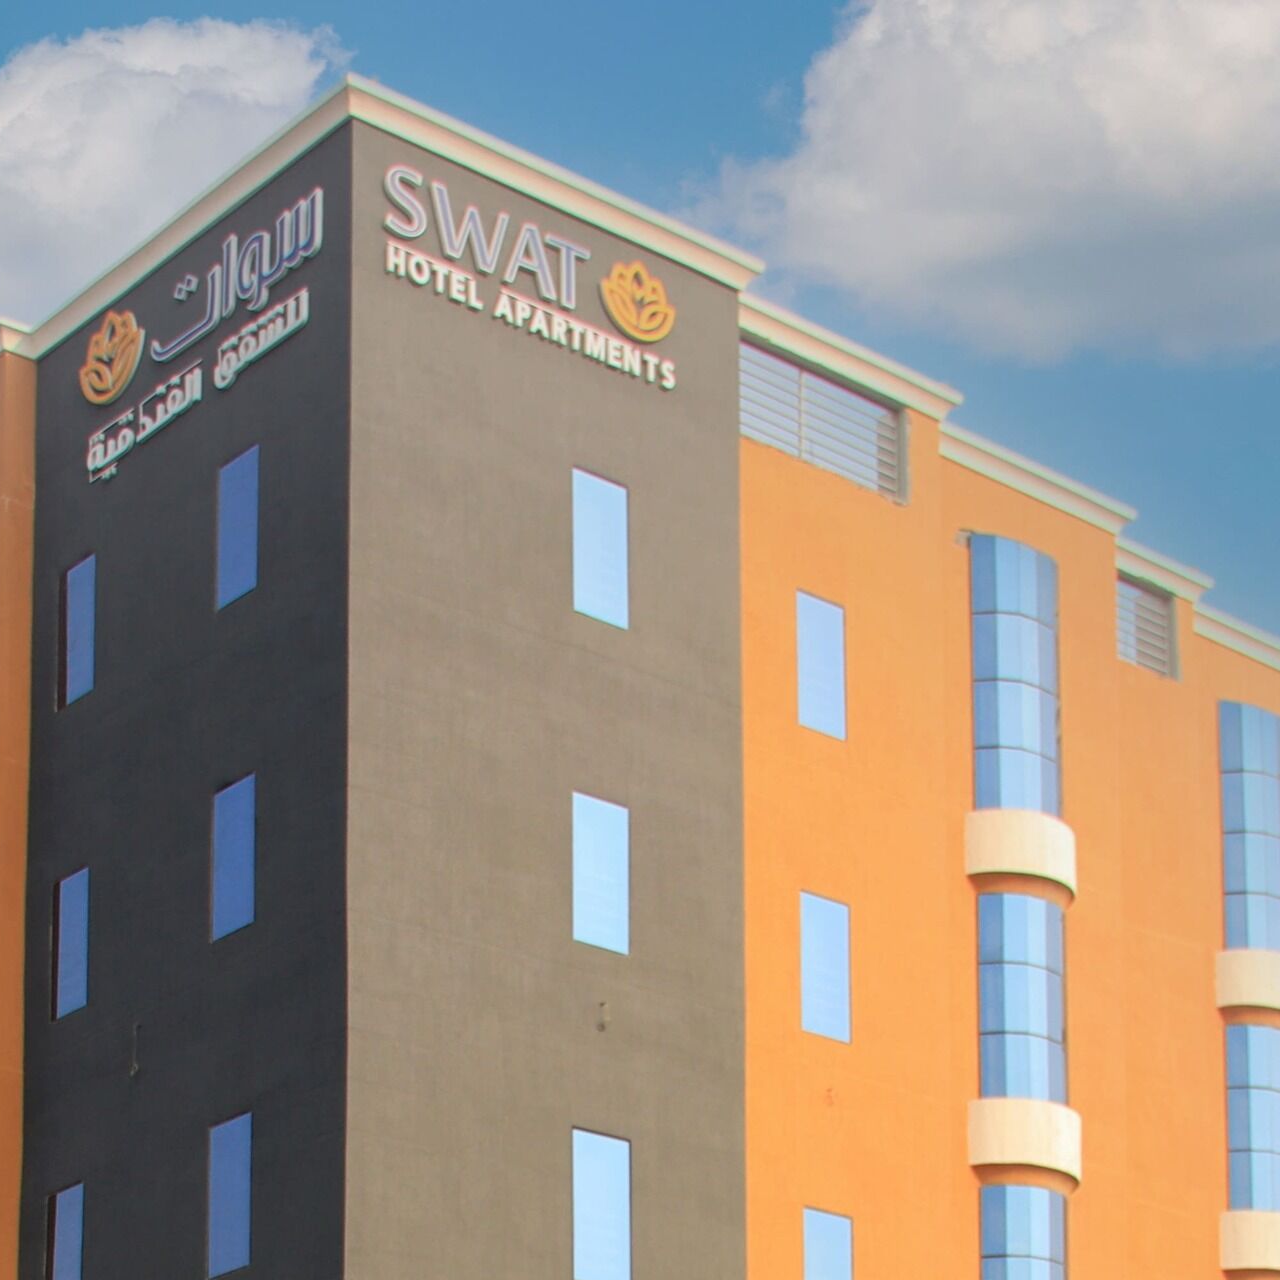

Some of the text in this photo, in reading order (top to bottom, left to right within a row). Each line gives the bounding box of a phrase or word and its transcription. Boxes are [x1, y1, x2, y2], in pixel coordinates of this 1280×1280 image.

[150, 187, 324, 362] سوات
[384, 164, 591, 310] SWAT
[385, 241, 677, 390] HOTEL APARTMENTS
